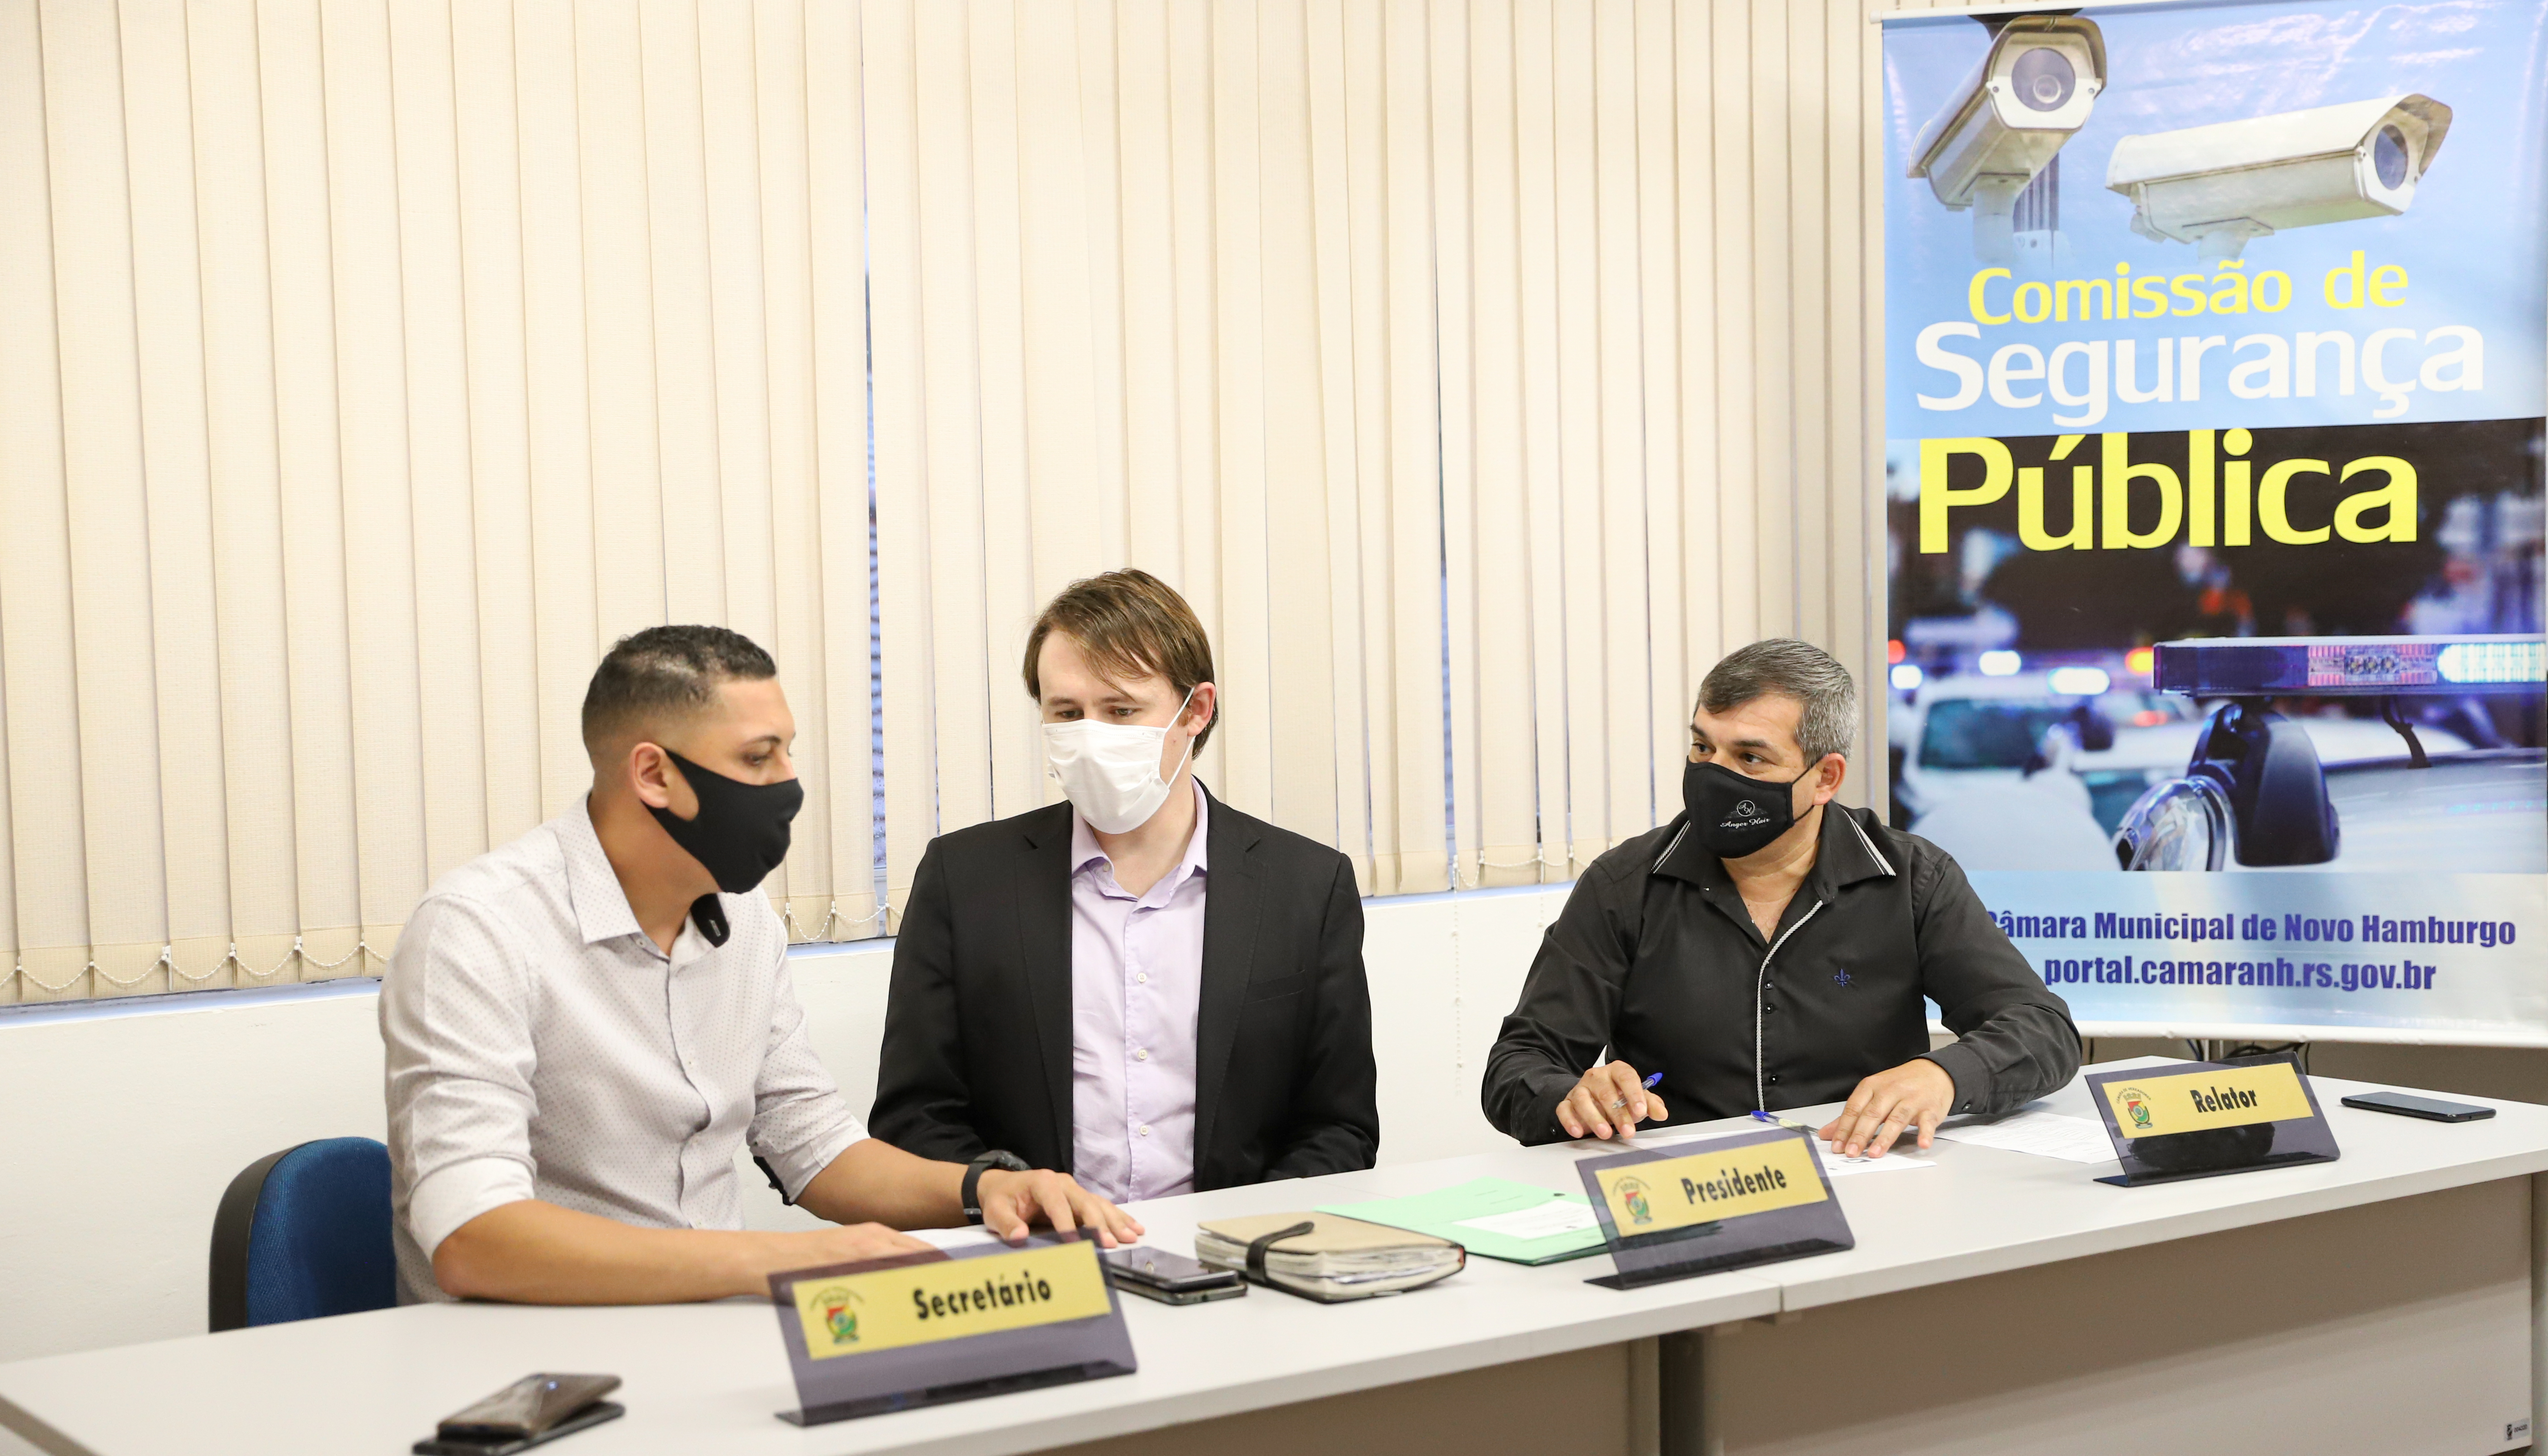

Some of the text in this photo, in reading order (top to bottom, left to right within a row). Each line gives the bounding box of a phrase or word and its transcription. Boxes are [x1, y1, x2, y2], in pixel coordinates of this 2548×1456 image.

[1969, 250, 2408, 325] Comissão de
[1915, 321, 2484, 427] Segurança
[1919, 428, 2418, 554] Pública
[1987, 910, 2515, 948] âmara Municipal de Novo Hamburgo
[2045, 956, 2436, 992] portal.camaranh.rs.gov.br
[2189, 1086, 2258, 1113] Relator
[1680, 1165, 1787, 1205] Presidente
[912, 1270, 1052, 1320] Secretário
